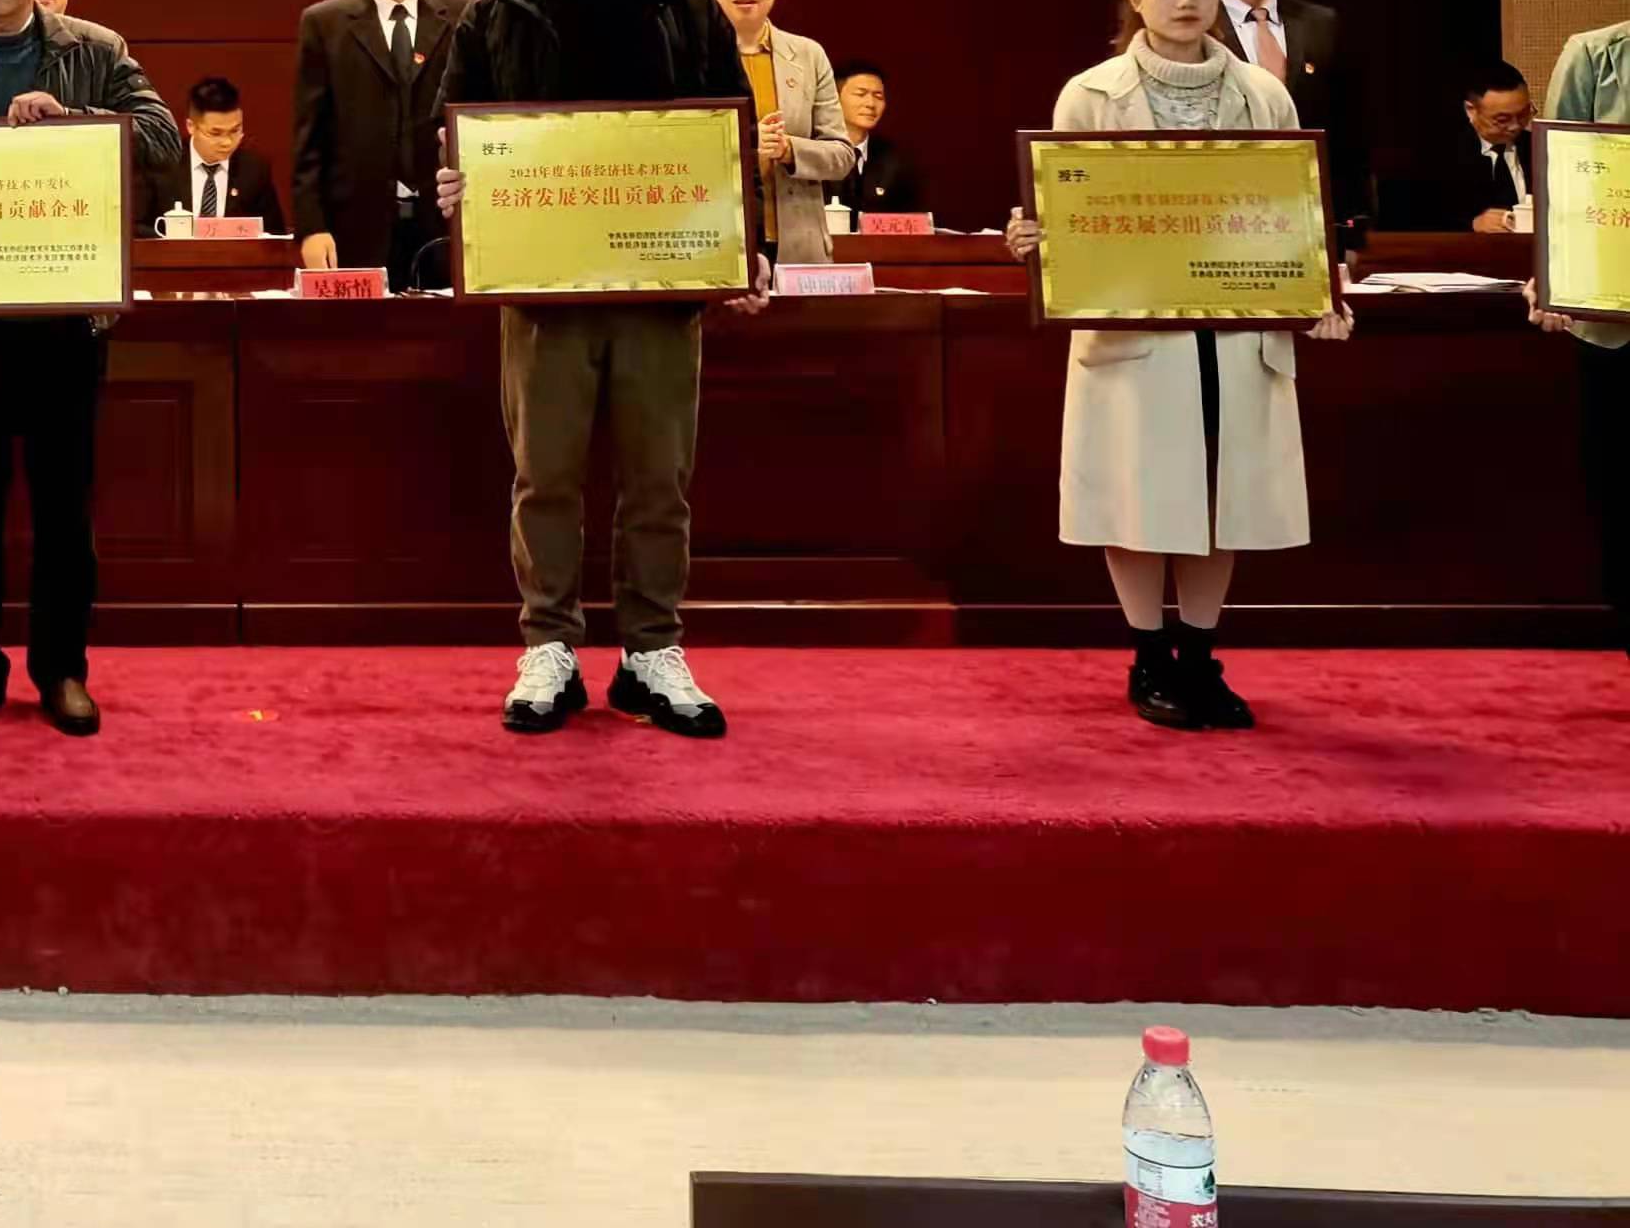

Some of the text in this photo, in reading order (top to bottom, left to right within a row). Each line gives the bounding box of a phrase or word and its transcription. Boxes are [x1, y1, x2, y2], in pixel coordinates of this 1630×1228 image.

[509, 163, 690, 179] 2021年度东侨经济技术开发区
[491, 184, 711, 208] 经济发展突出贡献企业
[1070, 212, 1293, 235] 经济发展突出贡献企业
